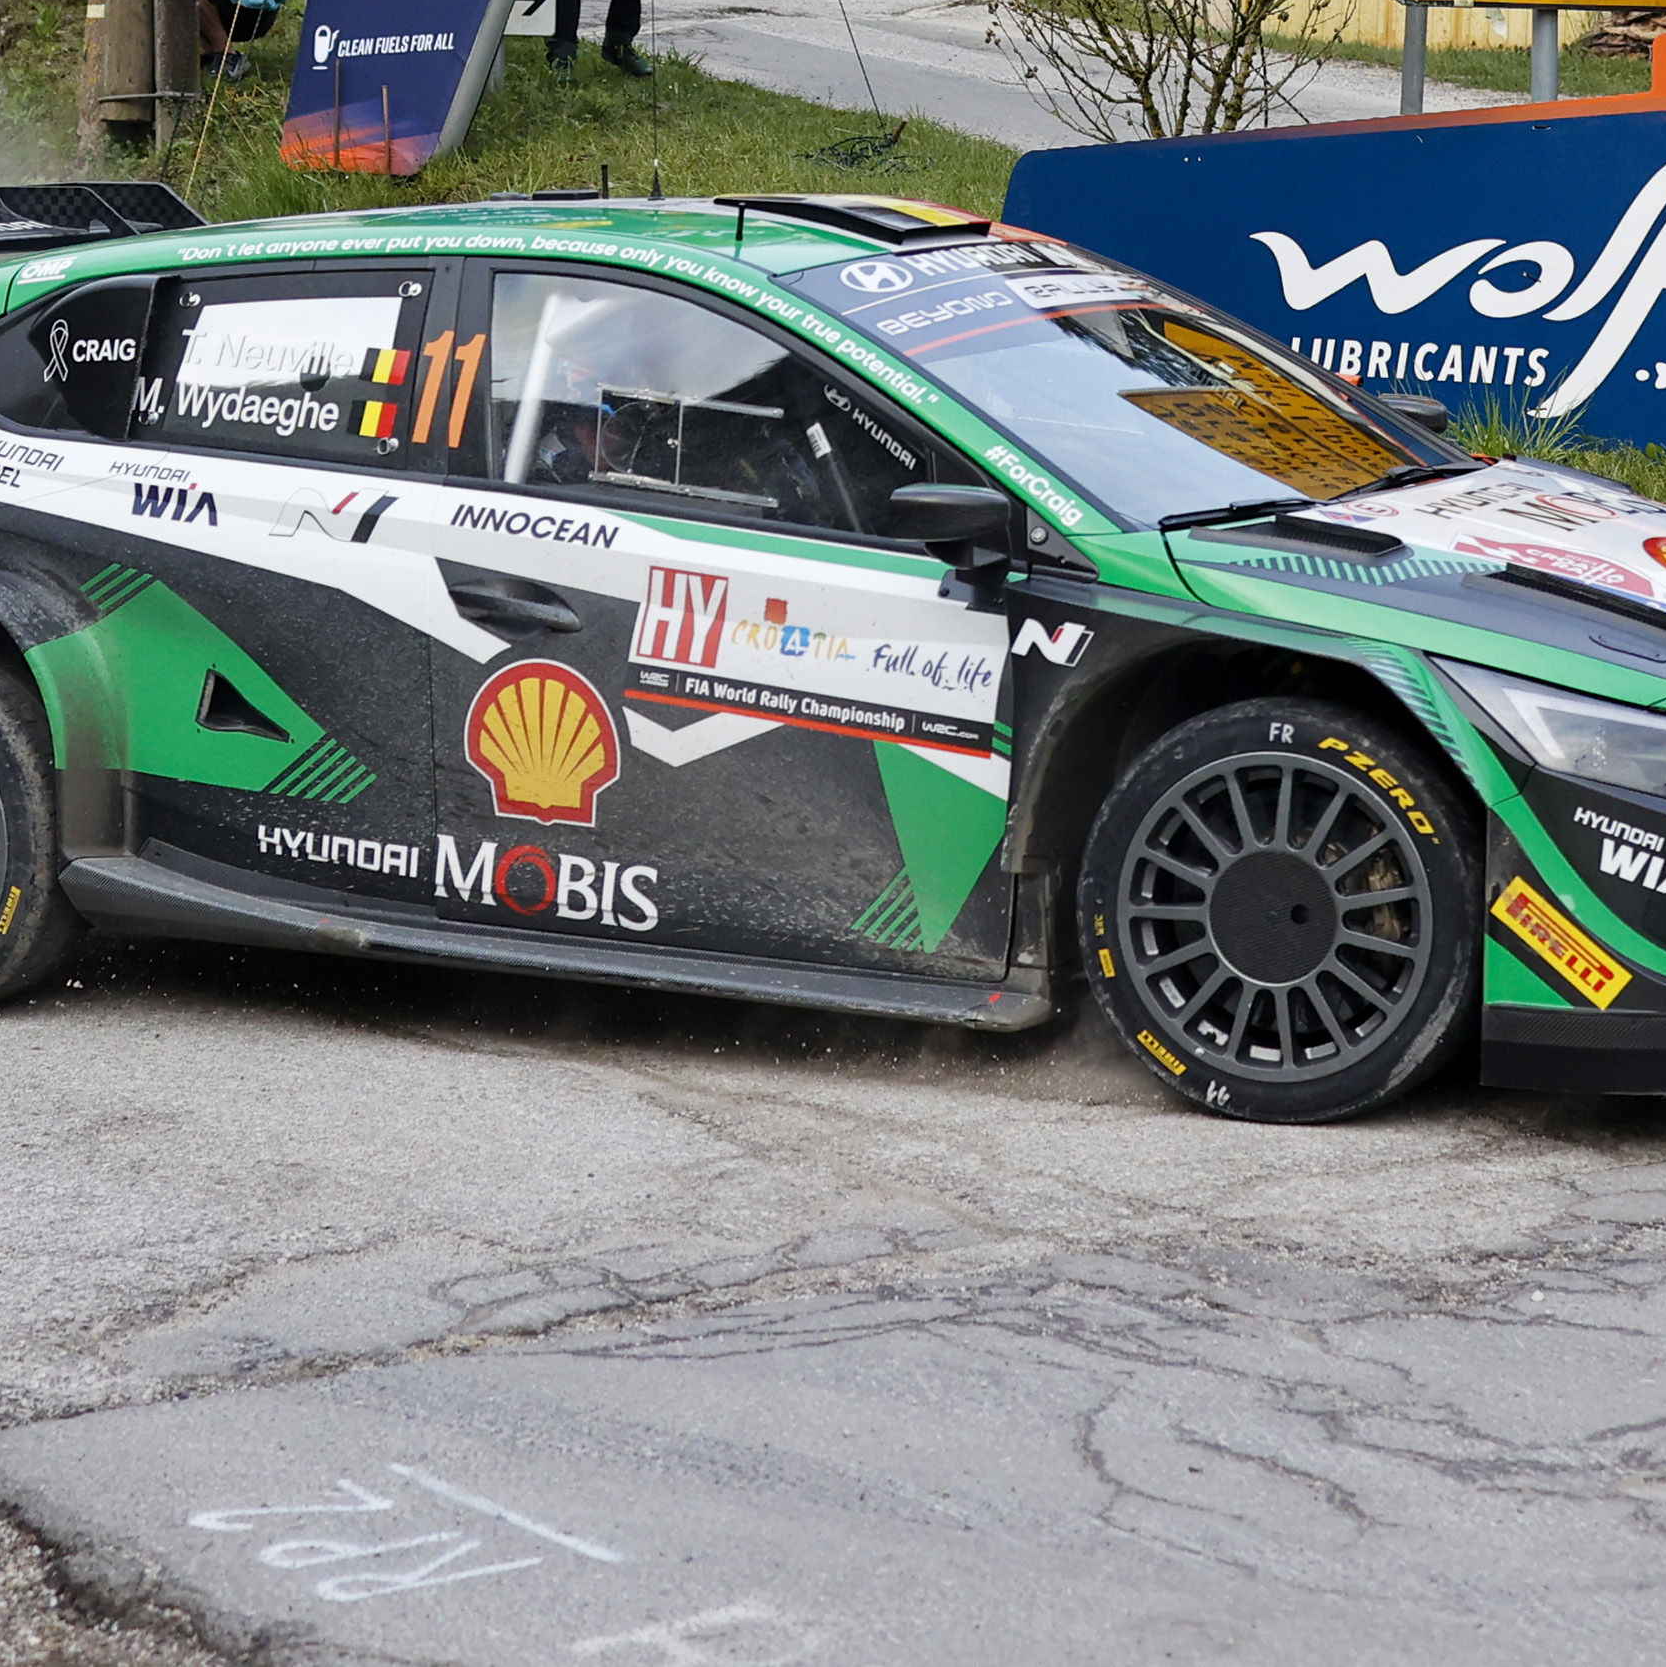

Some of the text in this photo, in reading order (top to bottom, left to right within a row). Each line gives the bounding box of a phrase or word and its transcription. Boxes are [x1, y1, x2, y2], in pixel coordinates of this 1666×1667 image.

[337, 33, 455, 58] CLEAN FUELS FOR ALL
[21, 256, 75, 282] OMP
[902, 242, 1047, 277] HYUNDAI
[238, 241, 263, 257] let
[265, 236, 340, 260] anyone
[341, 235, 387, 252] ever
[389, 234, 423, 253] put
[425, 234, 462, 254] you
[464, 233, 527, 252] down,
[531, 234, 616, 258] because
[619, 243, 665, 267] only
[666, 253, 704, 278] you
[704, 264, 761, 299] know
[753, 287, 804, 322] your
[801, 310, 838, 344] true
[876, 290, 1014, 337] BEYOND
[72, 338, 136, 363] CRAIG
[215, 332, 354, 378] Neuville
[131, 375, 341, 437] M. Wydaeghe
[411, 330, 488, 449] 11
[851, 407, 917, 472] HYUNDAI
[109, 460, 191, 481] HYUNDAI
[984, 443, 1085, 528] #ForCraig
[131, 483, 219, 527] WIA
[1415, 482, 1545, 520] HYUNDAI
[450, 503, 620, 550] INNOCEAN
[731, 620, 856, 661] CROATIA
[639, 670, 670, 683] WRC
[873, 643, 993, 694] Full of life
[685, 678, 906, 733] FIA World Rally Championship
[1268, 722, 1295, 745] FR
[1573, 806, 1665, 850] HYUNDAI
[257, 824, 660, 933] HYUNDAI MOBIS
[1506, 891, 1616, 994] PIRELLI
[1137, 1030, 1187, 1077] PIRELLI
